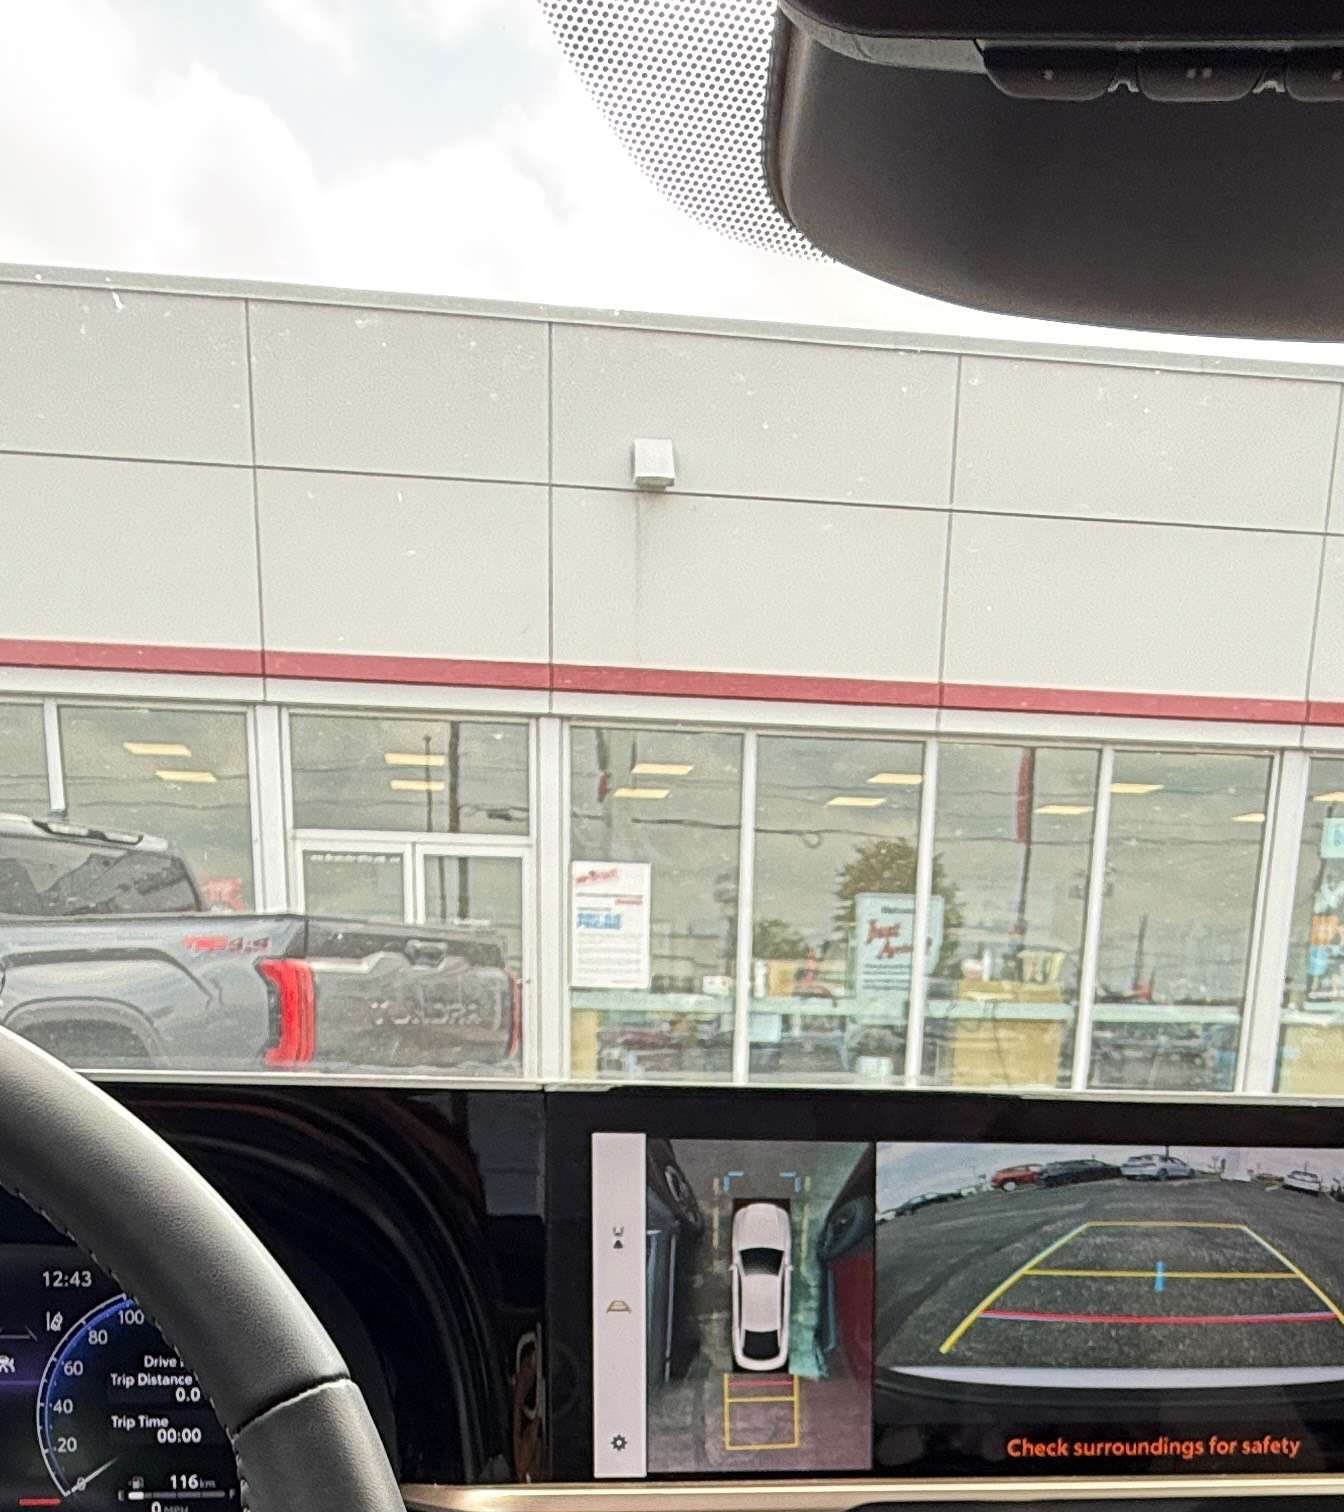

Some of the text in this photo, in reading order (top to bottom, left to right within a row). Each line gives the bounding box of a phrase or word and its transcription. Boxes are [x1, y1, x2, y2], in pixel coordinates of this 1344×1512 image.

[42, 1270, 93, 1288] 12:43
[119, 1310, 145, 1325] 100
[88, 1329, 108, 1345] 80
[63, 1360, 84, 1376] 60
[144, 1355, 177, 1368] Drive
[111, 1373, 193, 1389] Trip Distance
[175, 1387, 201, 1402] 0.0
[53, 1399, 73, 1414] 40
[111, 1415, 169, 1431] Trip Time
[157, 1428, 202, 1444] 00:00
[58, 1437, 78, 1453] 20
[1007, 1435, 1301, 1460] Check surroundings for safety
[170, 1474, 199, 1490] 116
